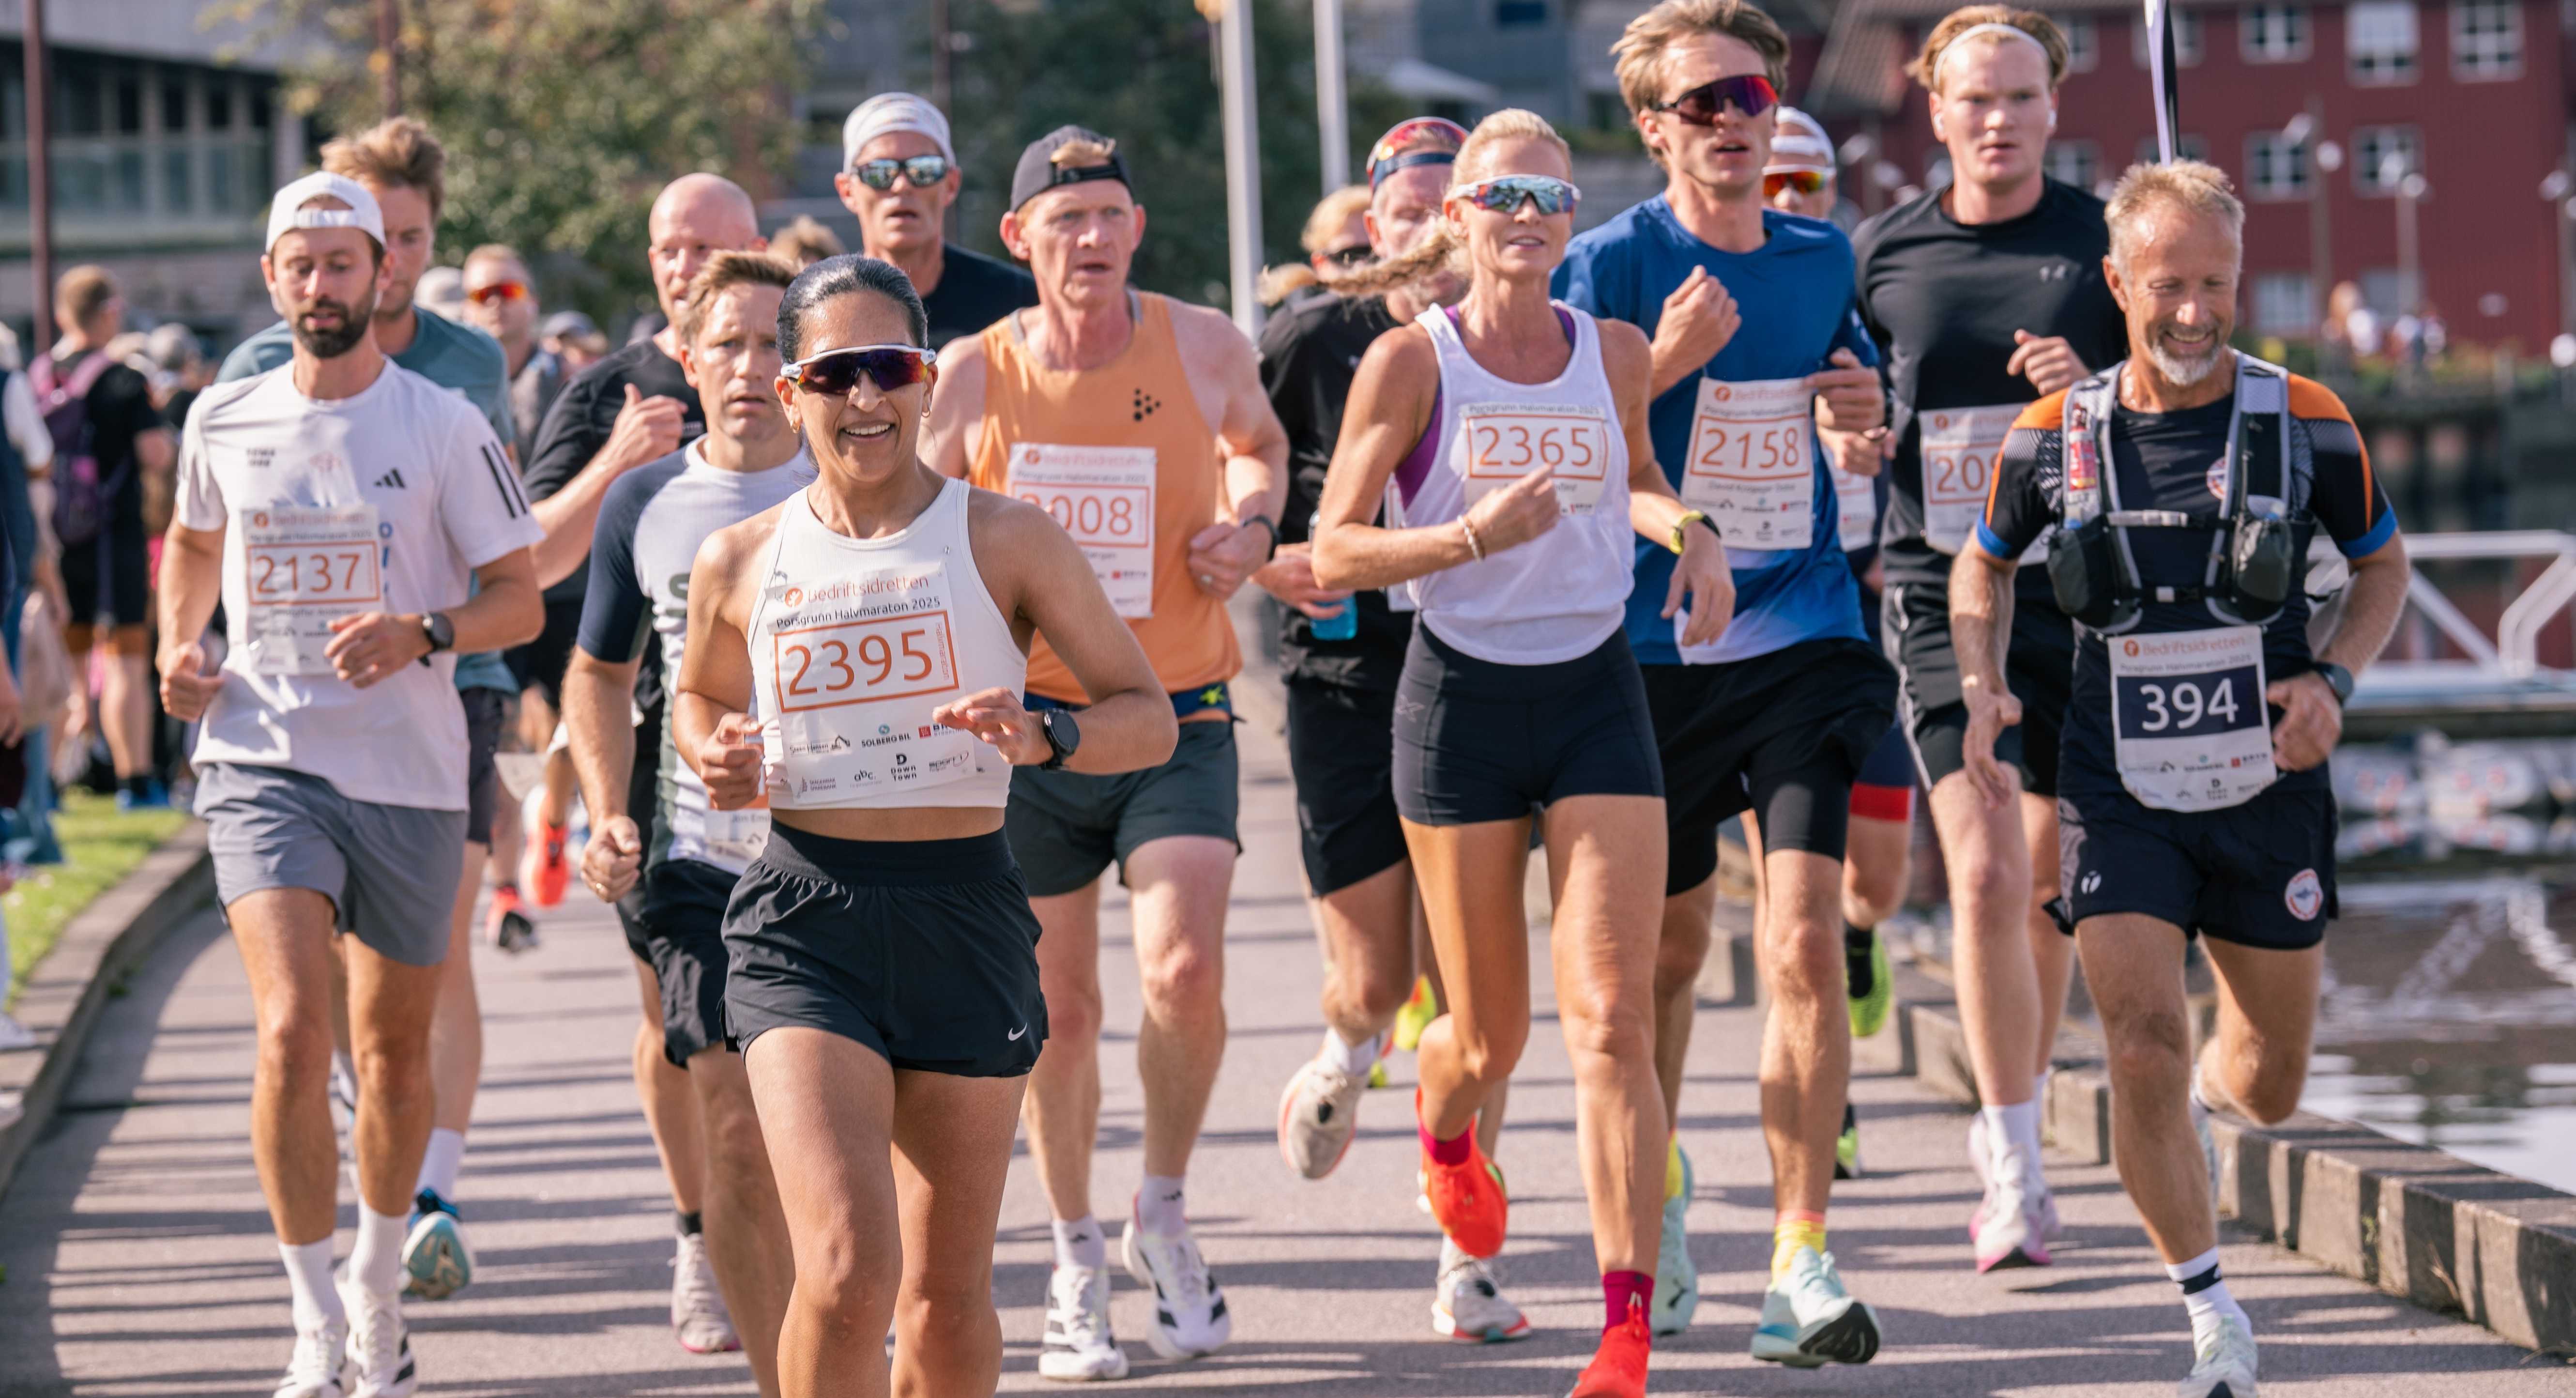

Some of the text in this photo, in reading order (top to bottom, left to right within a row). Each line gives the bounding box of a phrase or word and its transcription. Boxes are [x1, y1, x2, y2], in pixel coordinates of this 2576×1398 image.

[1476, 426, 1592, 467] 2365
[1700, 428, 1799, 469] 2158
[1936, 453, 1998, 493] 20
[255, 553, 361, 594] 2137
[808, 574, 929, 604] Bedriftsidretten
[776, 596, 941, 630] Porsgrunn Halvmaraton 2025
[785, 630, 932, 696] 2395
[2143, 635, 2245, 656] Bedriftsidretten
[2139, 677, 2239, 731] 394
[862, 732, 912, 748] SOLBERG BIL
[891, 765, 916, 774] Down
[893, 773, 917, 782] Town
